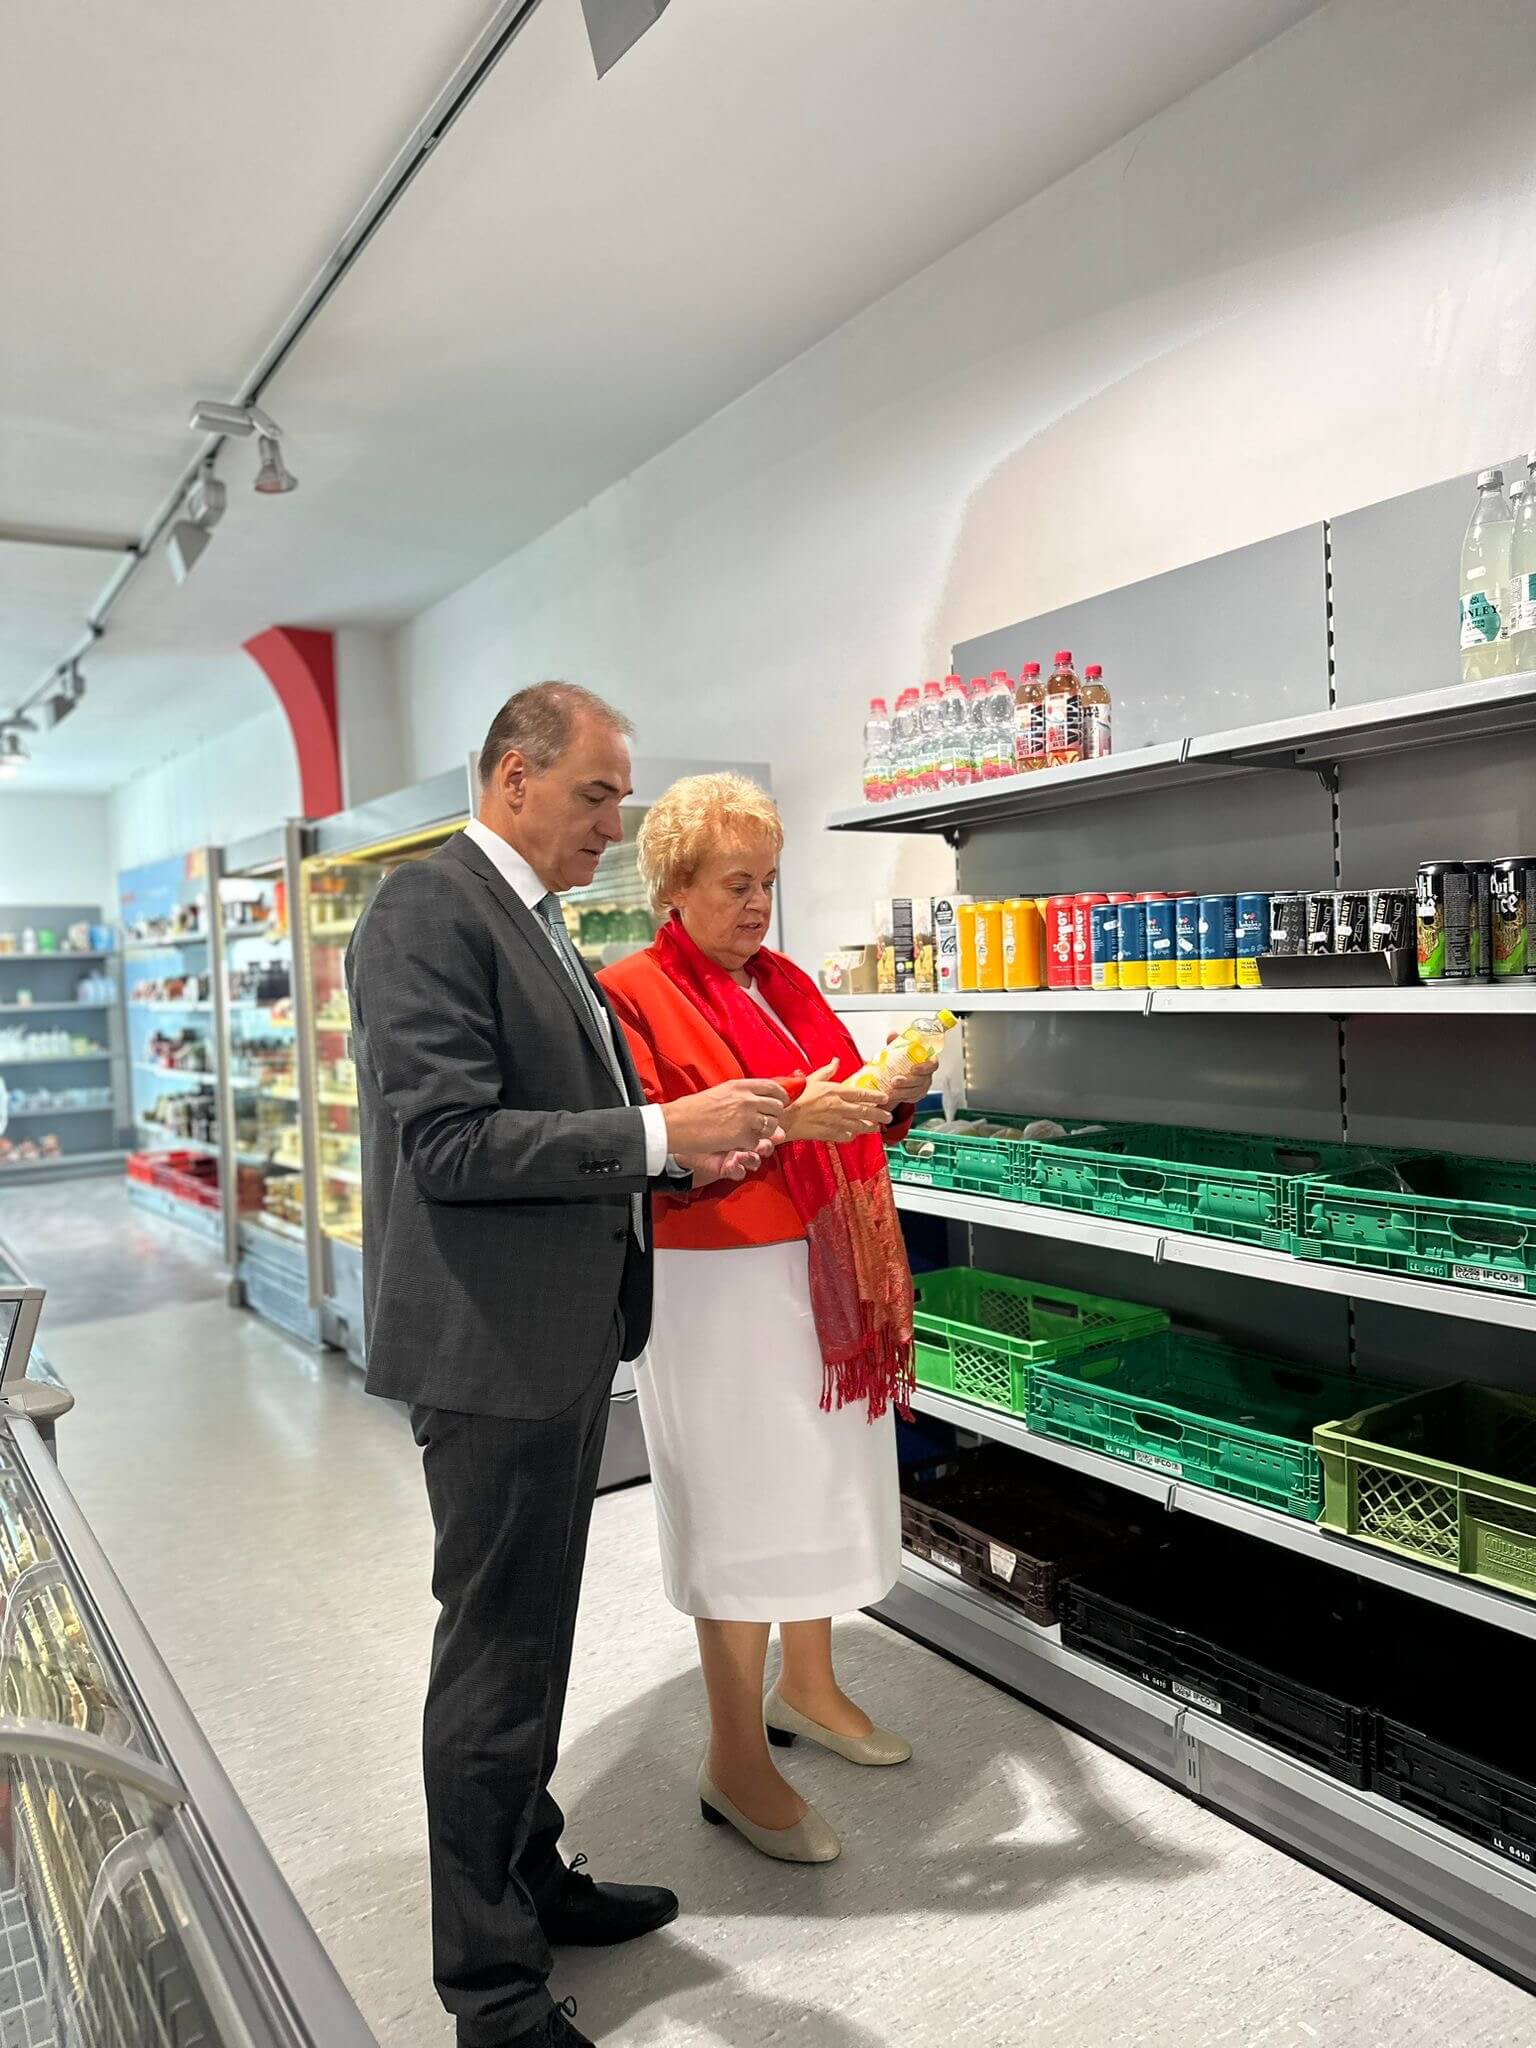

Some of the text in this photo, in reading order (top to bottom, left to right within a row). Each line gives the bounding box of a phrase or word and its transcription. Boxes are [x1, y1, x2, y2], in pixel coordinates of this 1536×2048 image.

[1482, 1270, 1509, 1281] IFCO
[1154, 1456, 1172, 1468] IFCO
[1493, 1837, 1531, 1862] LL 6410
